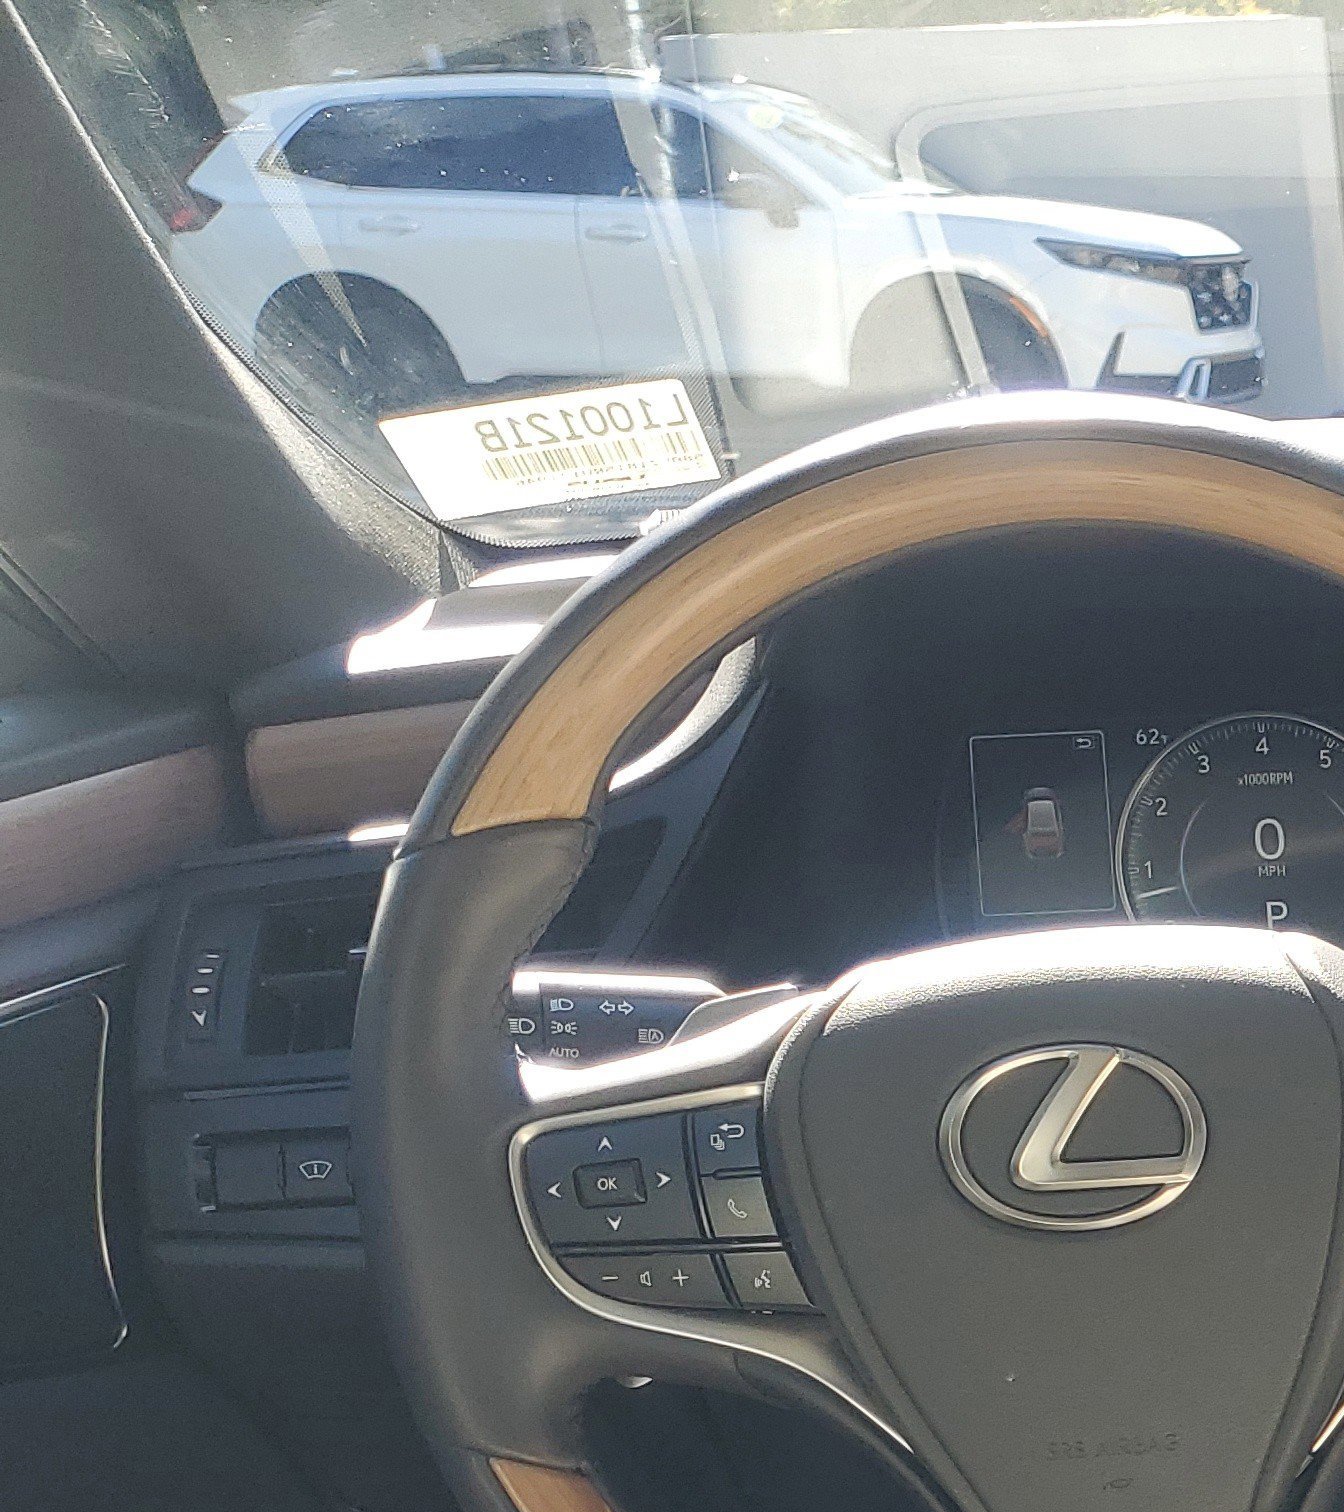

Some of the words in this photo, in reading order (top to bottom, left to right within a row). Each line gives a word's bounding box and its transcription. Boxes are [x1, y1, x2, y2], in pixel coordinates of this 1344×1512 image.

[1255, 737, 1269, 755] 4
[1199, 755, 1210, 773] 3
[1320, 750, 1332, 768] 5
[1156, 798, 1168, 816] 2
[1254, 817, 1286, 860] 0
[1144, 861, 1153, 879] 1
[1258, 865, 1287, 878] MPH
[1265, 901, 1288, 929] P
[548, 1047, 580, 1059] AUTO
[597, 1176, 618, 1191] OK
